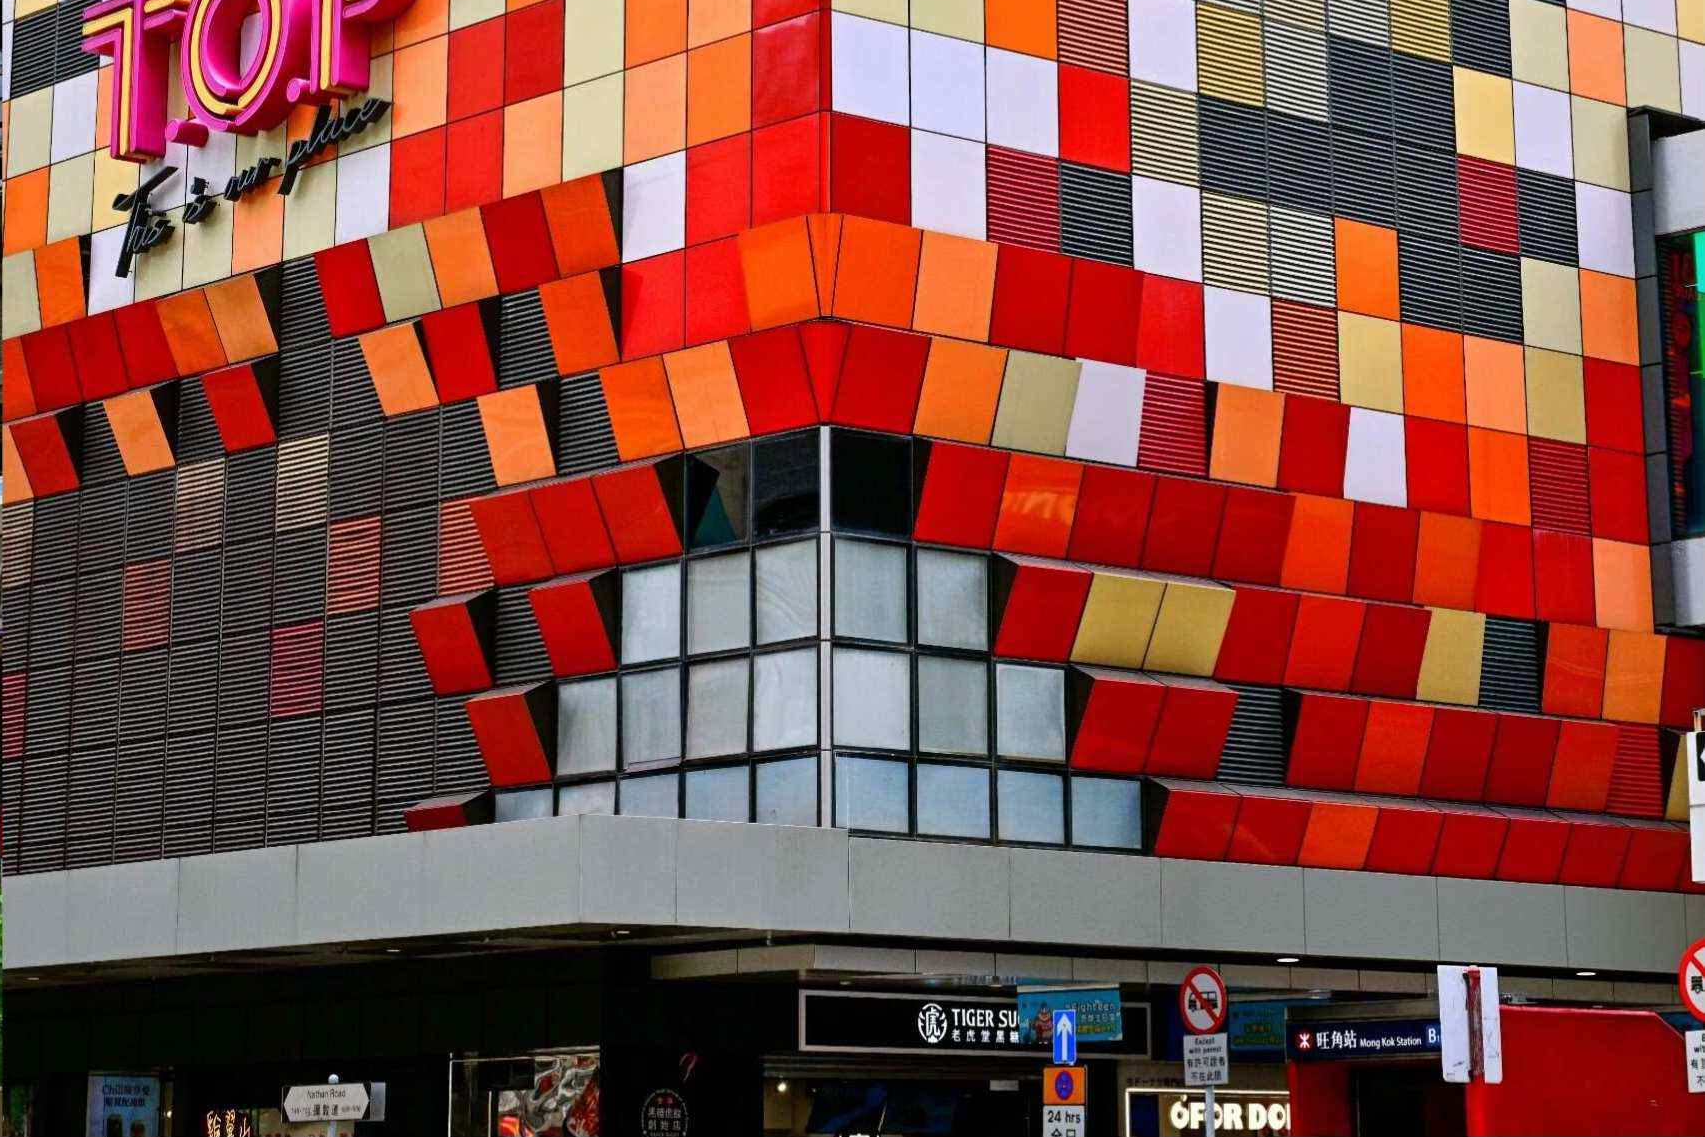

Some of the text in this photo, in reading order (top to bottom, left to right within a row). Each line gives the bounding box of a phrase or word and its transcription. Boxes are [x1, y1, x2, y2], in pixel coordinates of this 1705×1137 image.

[951, 1008, 1020, 1028] TIGER SU
[1316, 1029, 1357, 1050] 旺角站
[1360, 1038, 1381, 1049] Mong
[1381, 1037, 1395, 1047] Kok
[1396, 1035, 1422, 1047] Station
[307, 1088, 346, 1100] Nathan Road
[1047, 1110, 1081, 1124] 24 hrs
